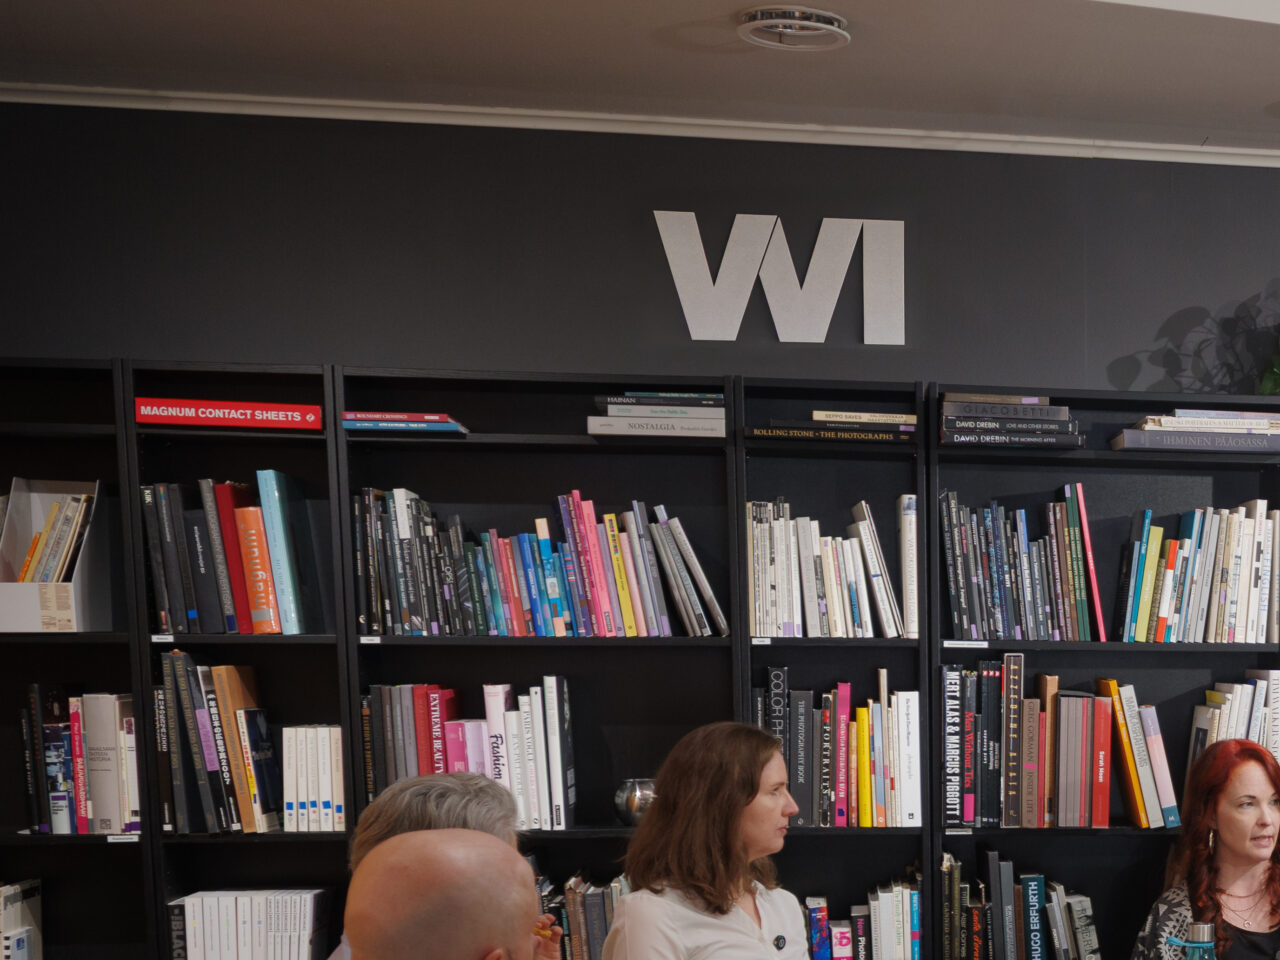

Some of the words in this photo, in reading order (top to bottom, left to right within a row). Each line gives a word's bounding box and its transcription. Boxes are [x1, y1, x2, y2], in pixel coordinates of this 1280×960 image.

[141, 406, 195, 416] MAGNUM
[198, 408, 252, 418] CONTACT
[255, 411, 301, 421] SHEETS
[628, 423, 675, 431] NOSTALGIA
[963, 406, 1050, 416] GIACOBETTI
[838, 432, 894, 440] PHOTOGRAPHS
[954, 434, 978, 442] DAVID
[981, 435, 1009, 443] DREBIN
[1163, 435, 1211, 445] IHMINEN
[246, 529, 267, 609] magnum
[1260, 558, 1271, 612] FINGLISH
[771, 671, 783, 716] COLOR
[947, 672, 959, 697] MERT
[429, 693, 441, 738] EXTREME
[946, 699, 959, 723] ALAS
[964, 711, 974, 731] Men
[1271, 696, 1279, 736] WALKER
[772, 720, 783, 754] PHO
[797, 715, 805, 765] PHOTOGRAPHY
[947, 725, 959, 733] &
[433, 740, 444, 774] BEAUTY
[490, 734, 504, 780] Fashion
[822, 726, 831, 794] PORTRAITS
[946, 736, 959, 773] MARCUS
[964, 733, 974, 768] Without
[946, 776, 959, 815] PIGGOTT
[964, 771, 974, 788] Ties
[1028, 881, 1040, 930] ERFURTH
[1030, 932, 1041, 960] HUGO
[1076, 908, 1093, 953] ROBERT
